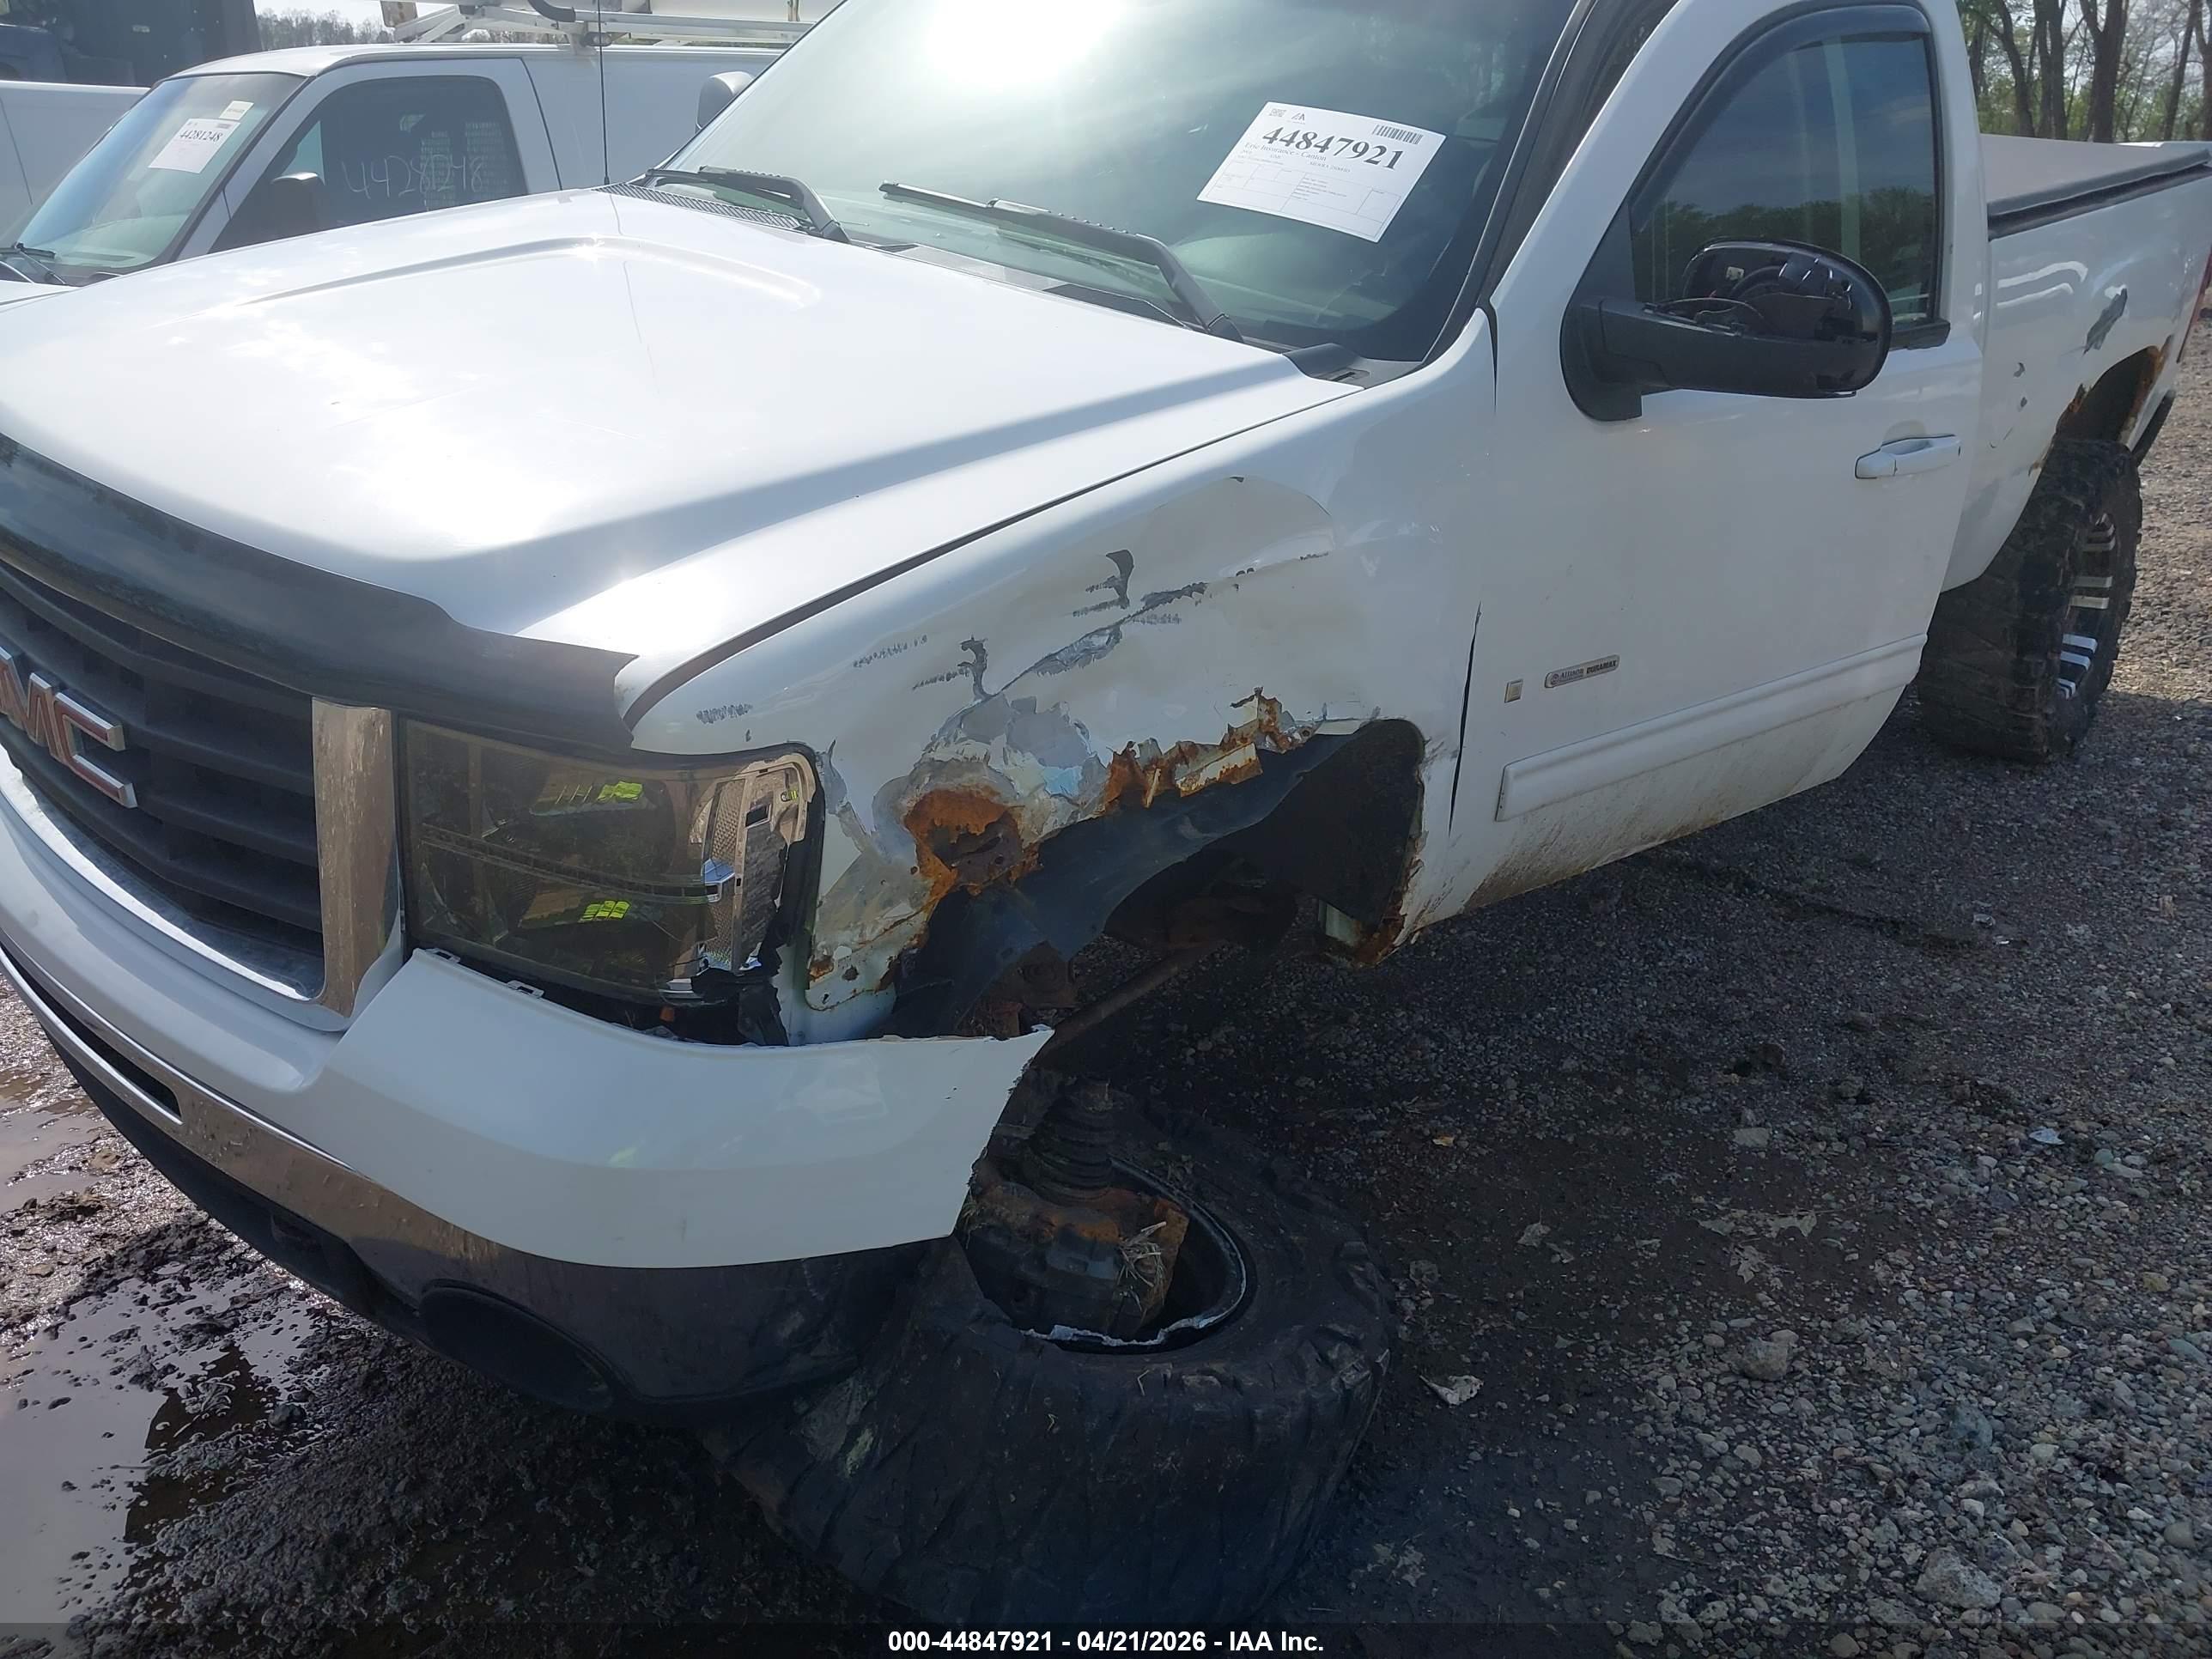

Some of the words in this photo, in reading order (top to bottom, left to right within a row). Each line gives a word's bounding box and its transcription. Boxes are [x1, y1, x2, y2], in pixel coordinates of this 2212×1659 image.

[179, 130, 223, 143] 44281248
[1261, 143, 1295, 155] Insurance
[1300, 149, 1327, 161] Canton
[1262, 126, 1405, 170] 44847921
[341, 154, 483, 199] 44281248
[1586, 659, 1616, 674] DURAMAX
